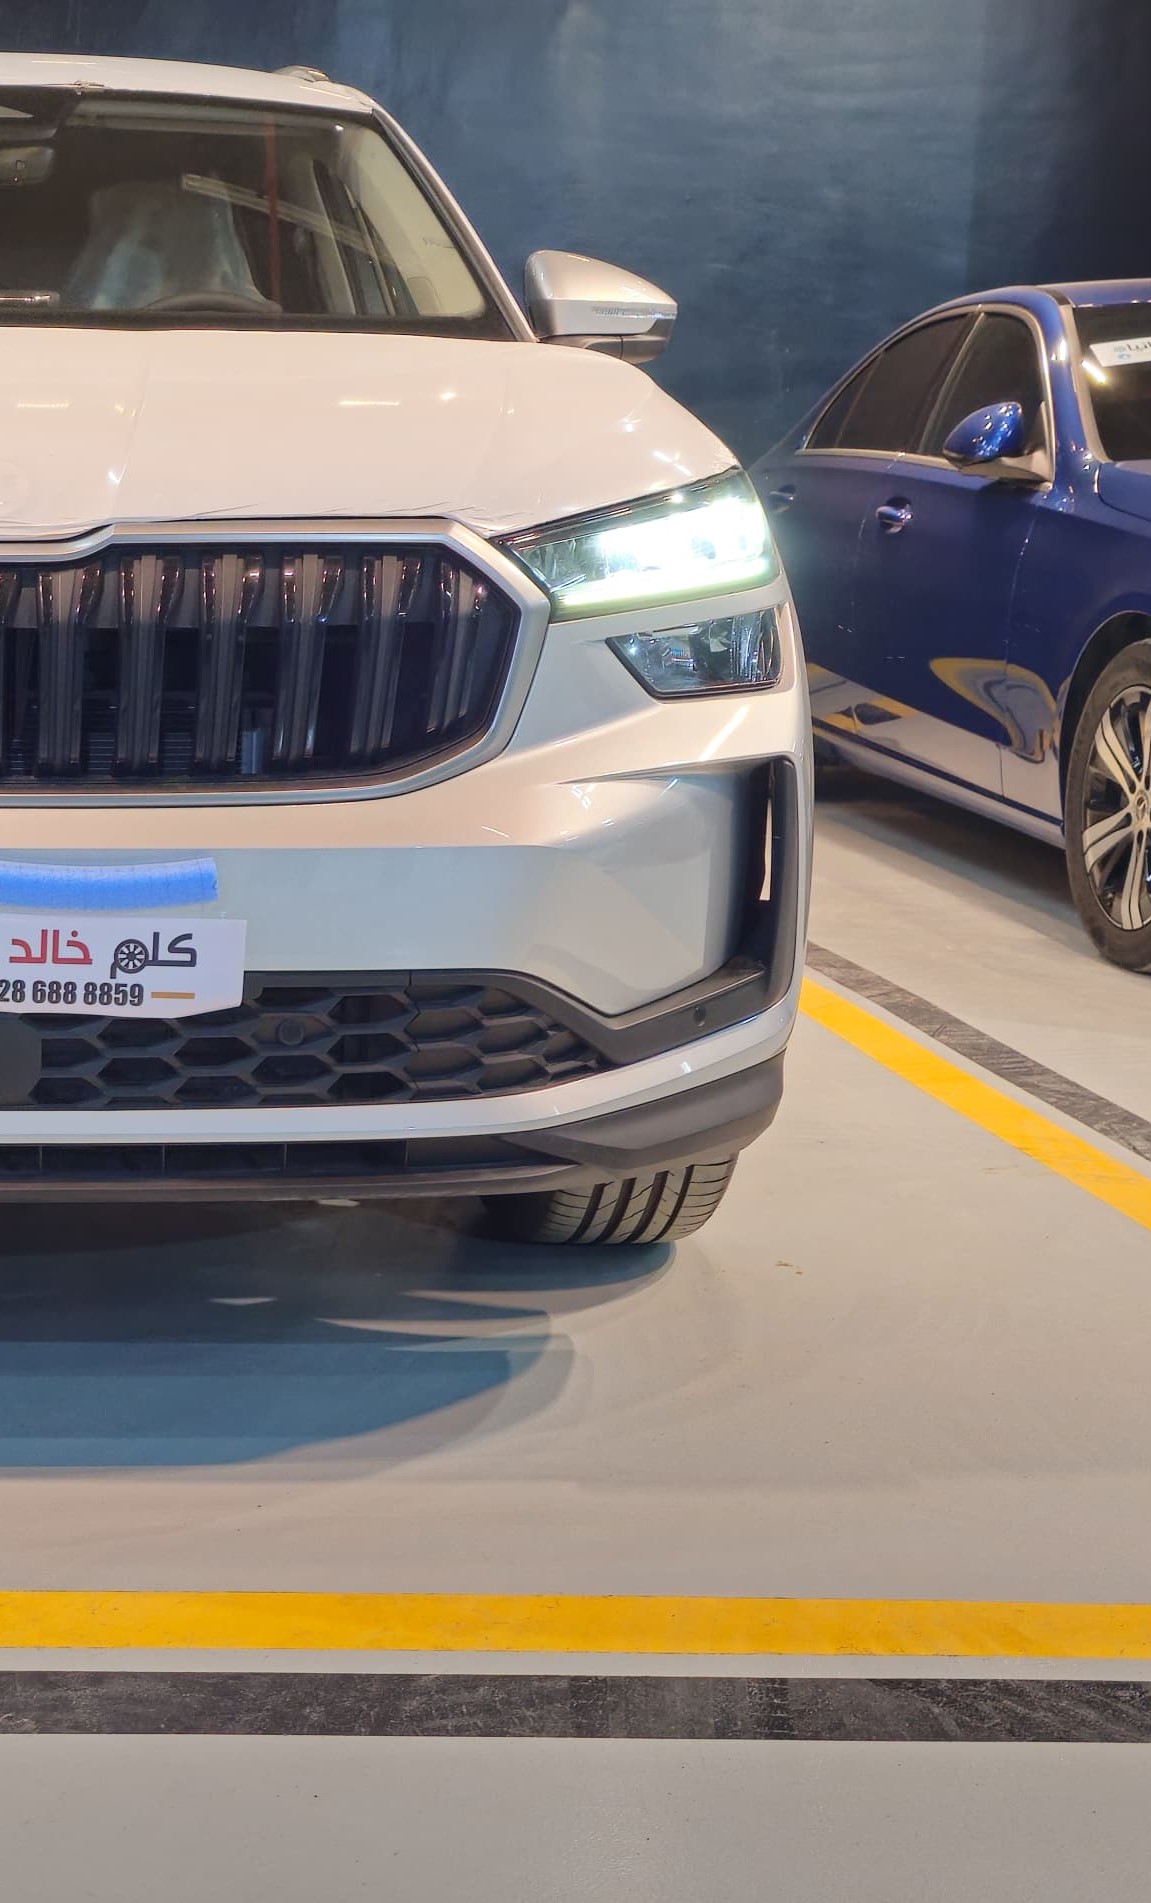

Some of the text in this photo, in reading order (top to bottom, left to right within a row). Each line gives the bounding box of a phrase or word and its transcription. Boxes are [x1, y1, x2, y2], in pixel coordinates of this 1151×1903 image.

[9, 928, 93, 965] خالد
[110, 931, 198, 980] كلم
[32, 980, 78, 1005] 688
[83, 982, 145, 1007] 8859
